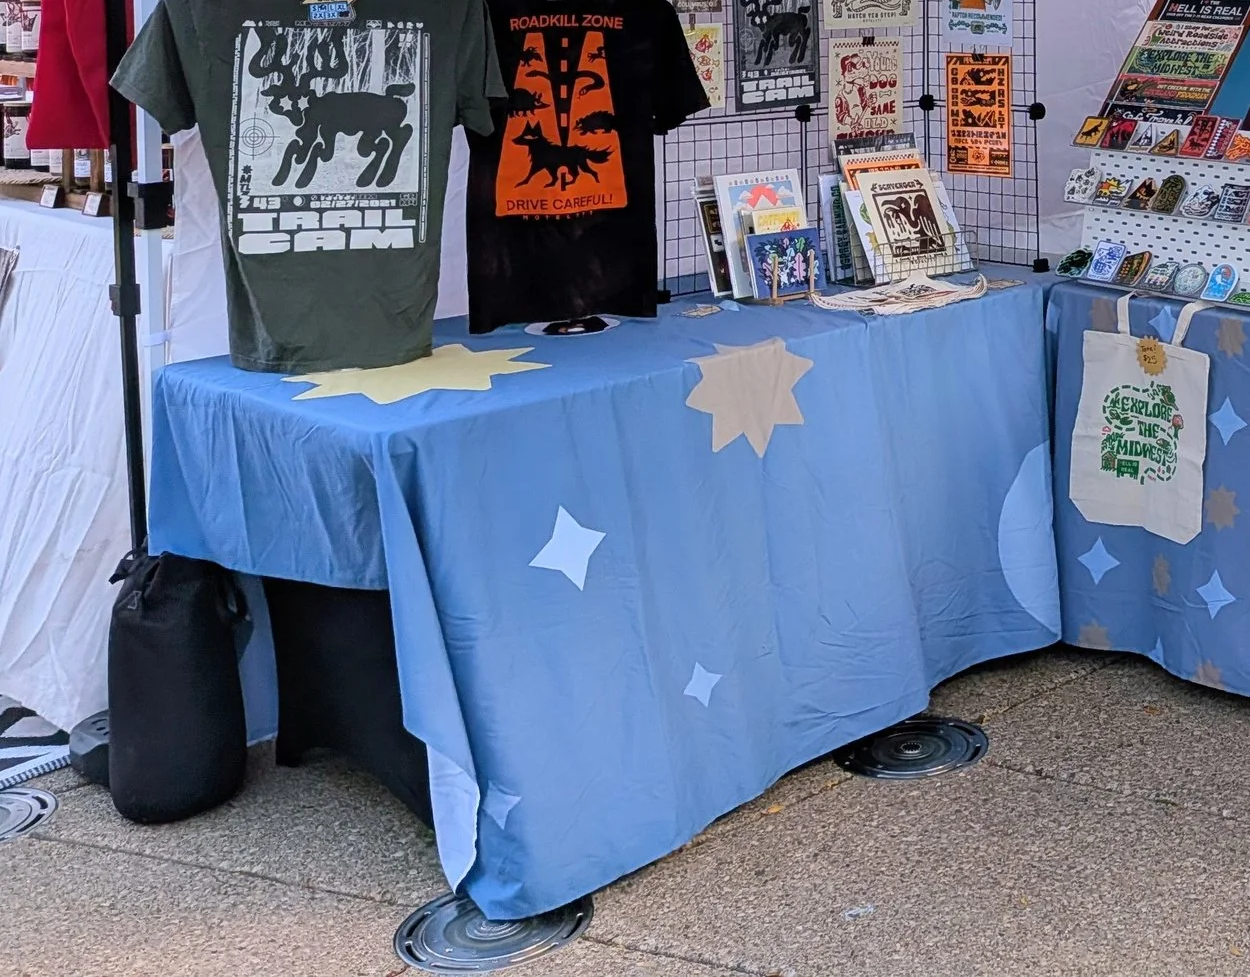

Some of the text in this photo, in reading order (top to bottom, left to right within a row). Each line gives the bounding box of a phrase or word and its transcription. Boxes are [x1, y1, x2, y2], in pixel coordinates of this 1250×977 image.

[1169, 3, 1243, 16] HELL IS REAL
[510, 14, 624, 31] ROADKILL ZONE
[1158, 30, 1185, 38] Weird
[1159, 37, 1219, 48] Attractions
[867, 51, 898, 72] YOUNG
[1150, 49, 1215, 63] EXPLORE THE
[1151, 63, 1200, 76] MIDWEST
[741, 75, 815, 92] TRAIL
[868, 74, 898, 90] DOG
[742, 85, 815, 104] CAM
[870, 100, 896, 116] SAME
[864, 117, 888, 130] OLD
[878, 181, 916, 191] SCAVENGER
[253, 196, 281, 209] 43
[310, 199, 396, 208] 02/27/2021
[506, 193, 613, 211] DRIVE CAREFUL!
[237, 208, 416, 232] TRAIL
[238, 228, 414, 254] CAM
[1143, 354, 1157, 364] $25
[1121, 396, 1172, 423] EXPLORE
[1137, 420, 1160, 439] THE
[1116, 439, 1168, 466] MIDWEST
